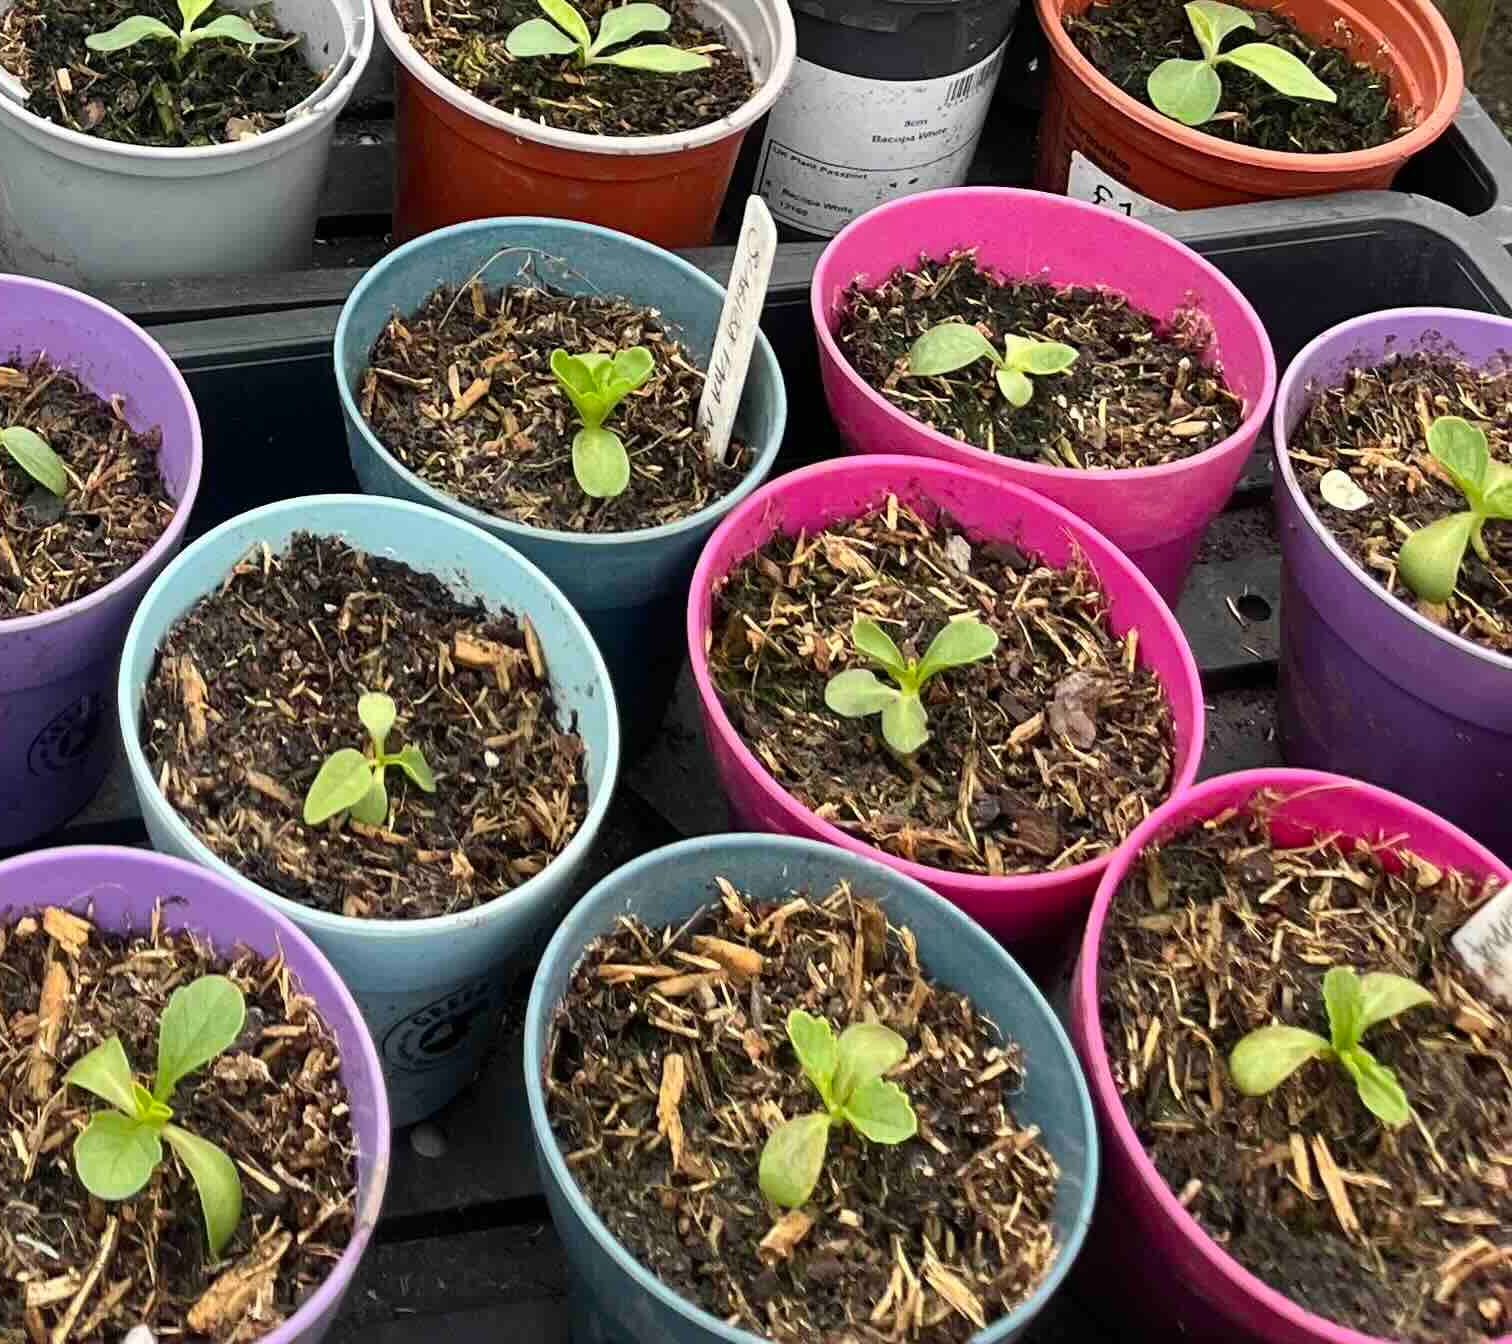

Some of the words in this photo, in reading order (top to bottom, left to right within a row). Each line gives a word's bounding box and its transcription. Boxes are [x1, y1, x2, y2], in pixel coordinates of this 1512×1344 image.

[872, 135, 915, 145] Bacopa
[790, 155, 817, 170] Plant
[819, 166, 868, 180] Passport
